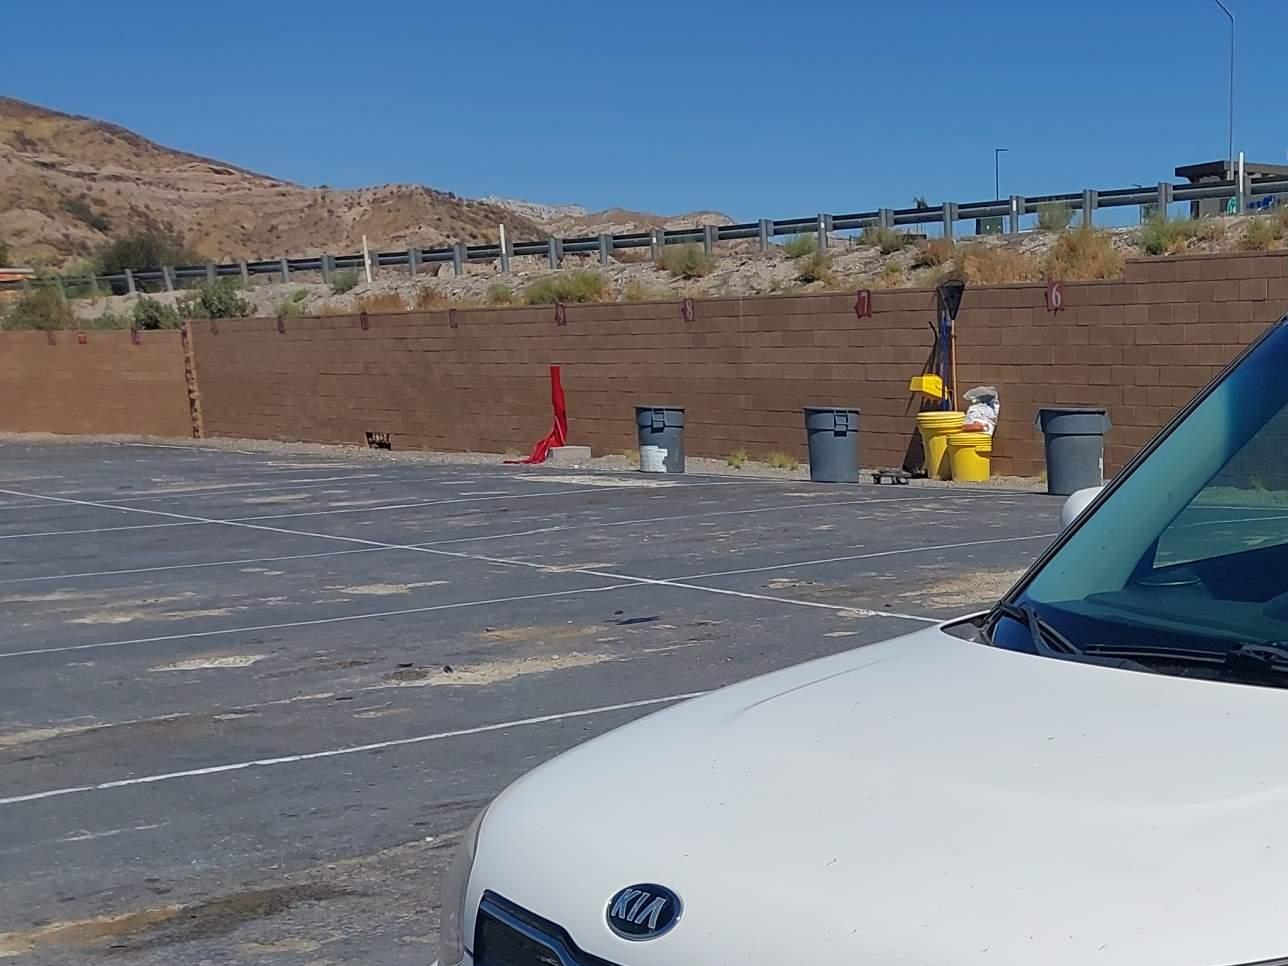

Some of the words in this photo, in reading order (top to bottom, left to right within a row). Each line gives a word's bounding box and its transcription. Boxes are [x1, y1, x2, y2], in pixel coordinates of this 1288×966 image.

[860, 291, 868, 313] 7
[1052, 283, 1061, 306] 6
[686, 299, 693, 320] 8
[611, 888, 666, 929] KIA
